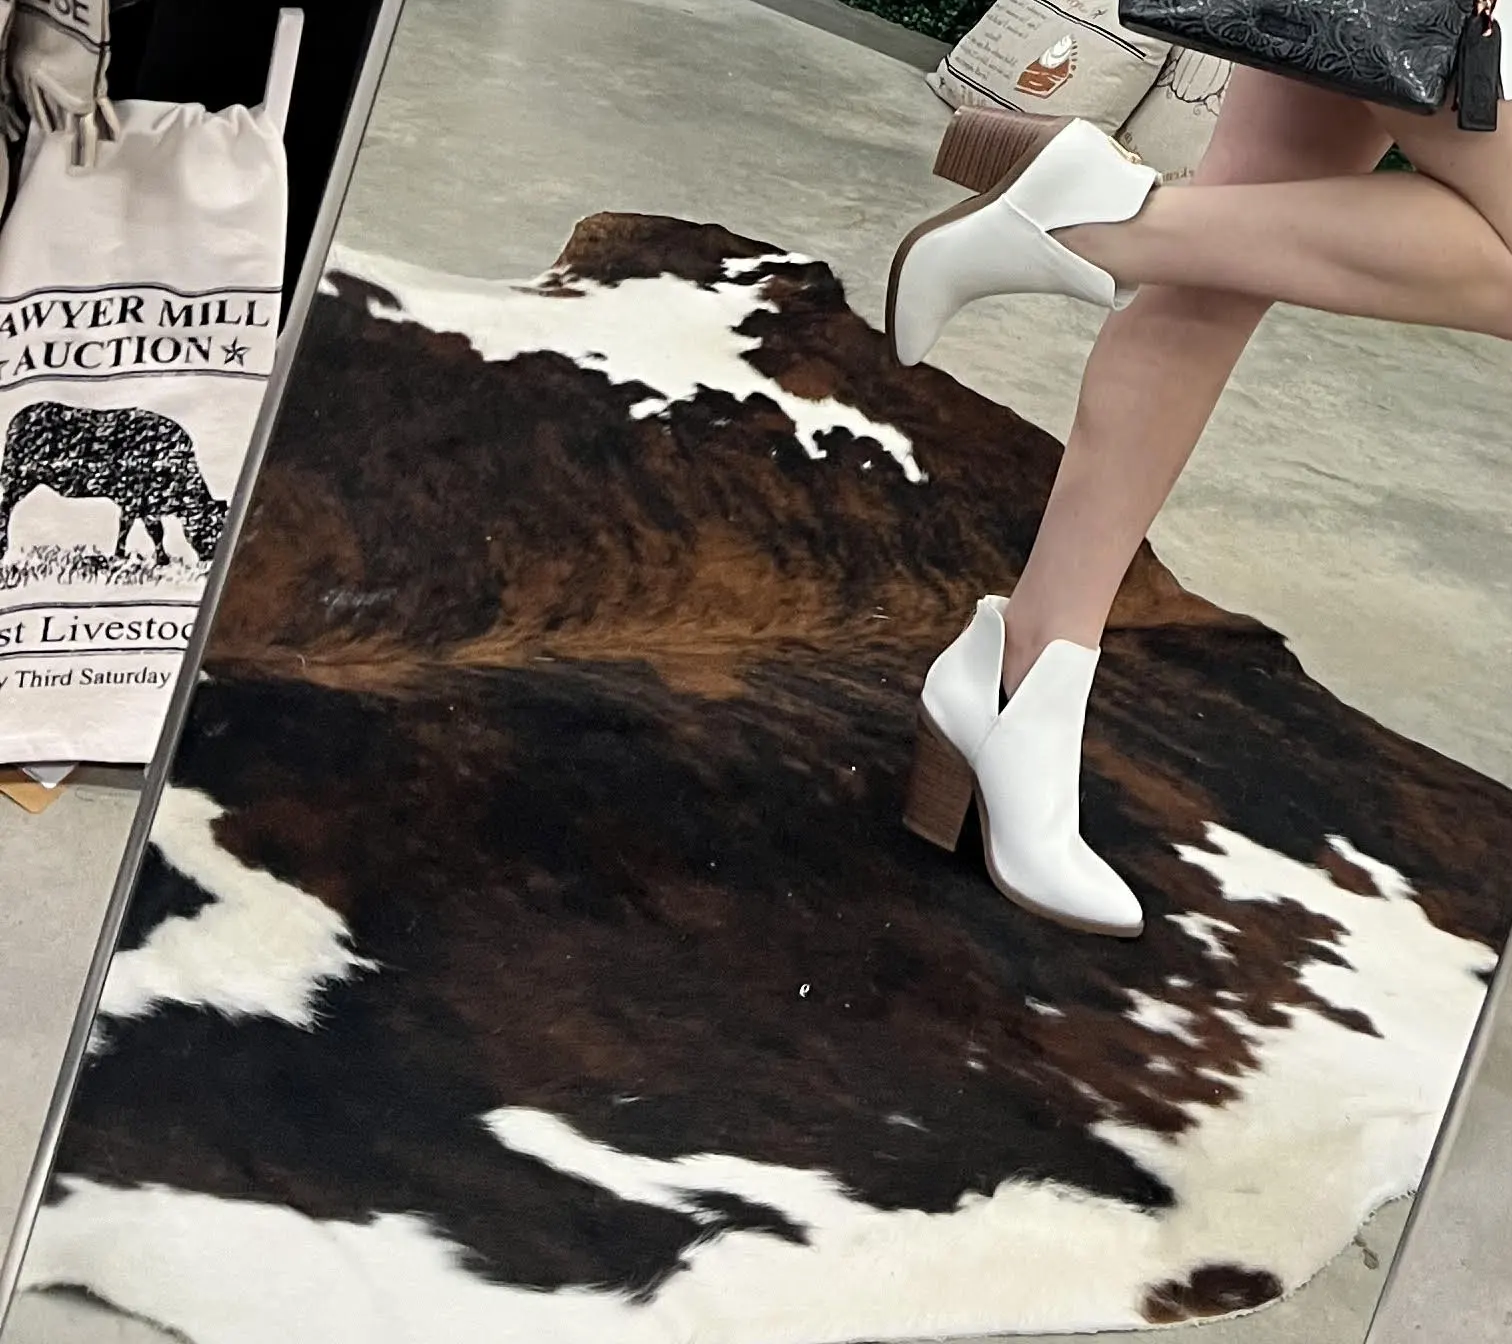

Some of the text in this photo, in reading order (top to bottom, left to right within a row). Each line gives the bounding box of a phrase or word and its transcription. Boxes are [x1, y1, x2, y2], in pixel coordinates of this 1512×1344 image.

[0, 295, 270, 339] AWYER MILL
[13, 336, 212, 376] AUCTION
[0, 615, 195, 647] st Livestoc
[15, 668, 73, 688] Third
[79, 667, 171, 689] Saturday
